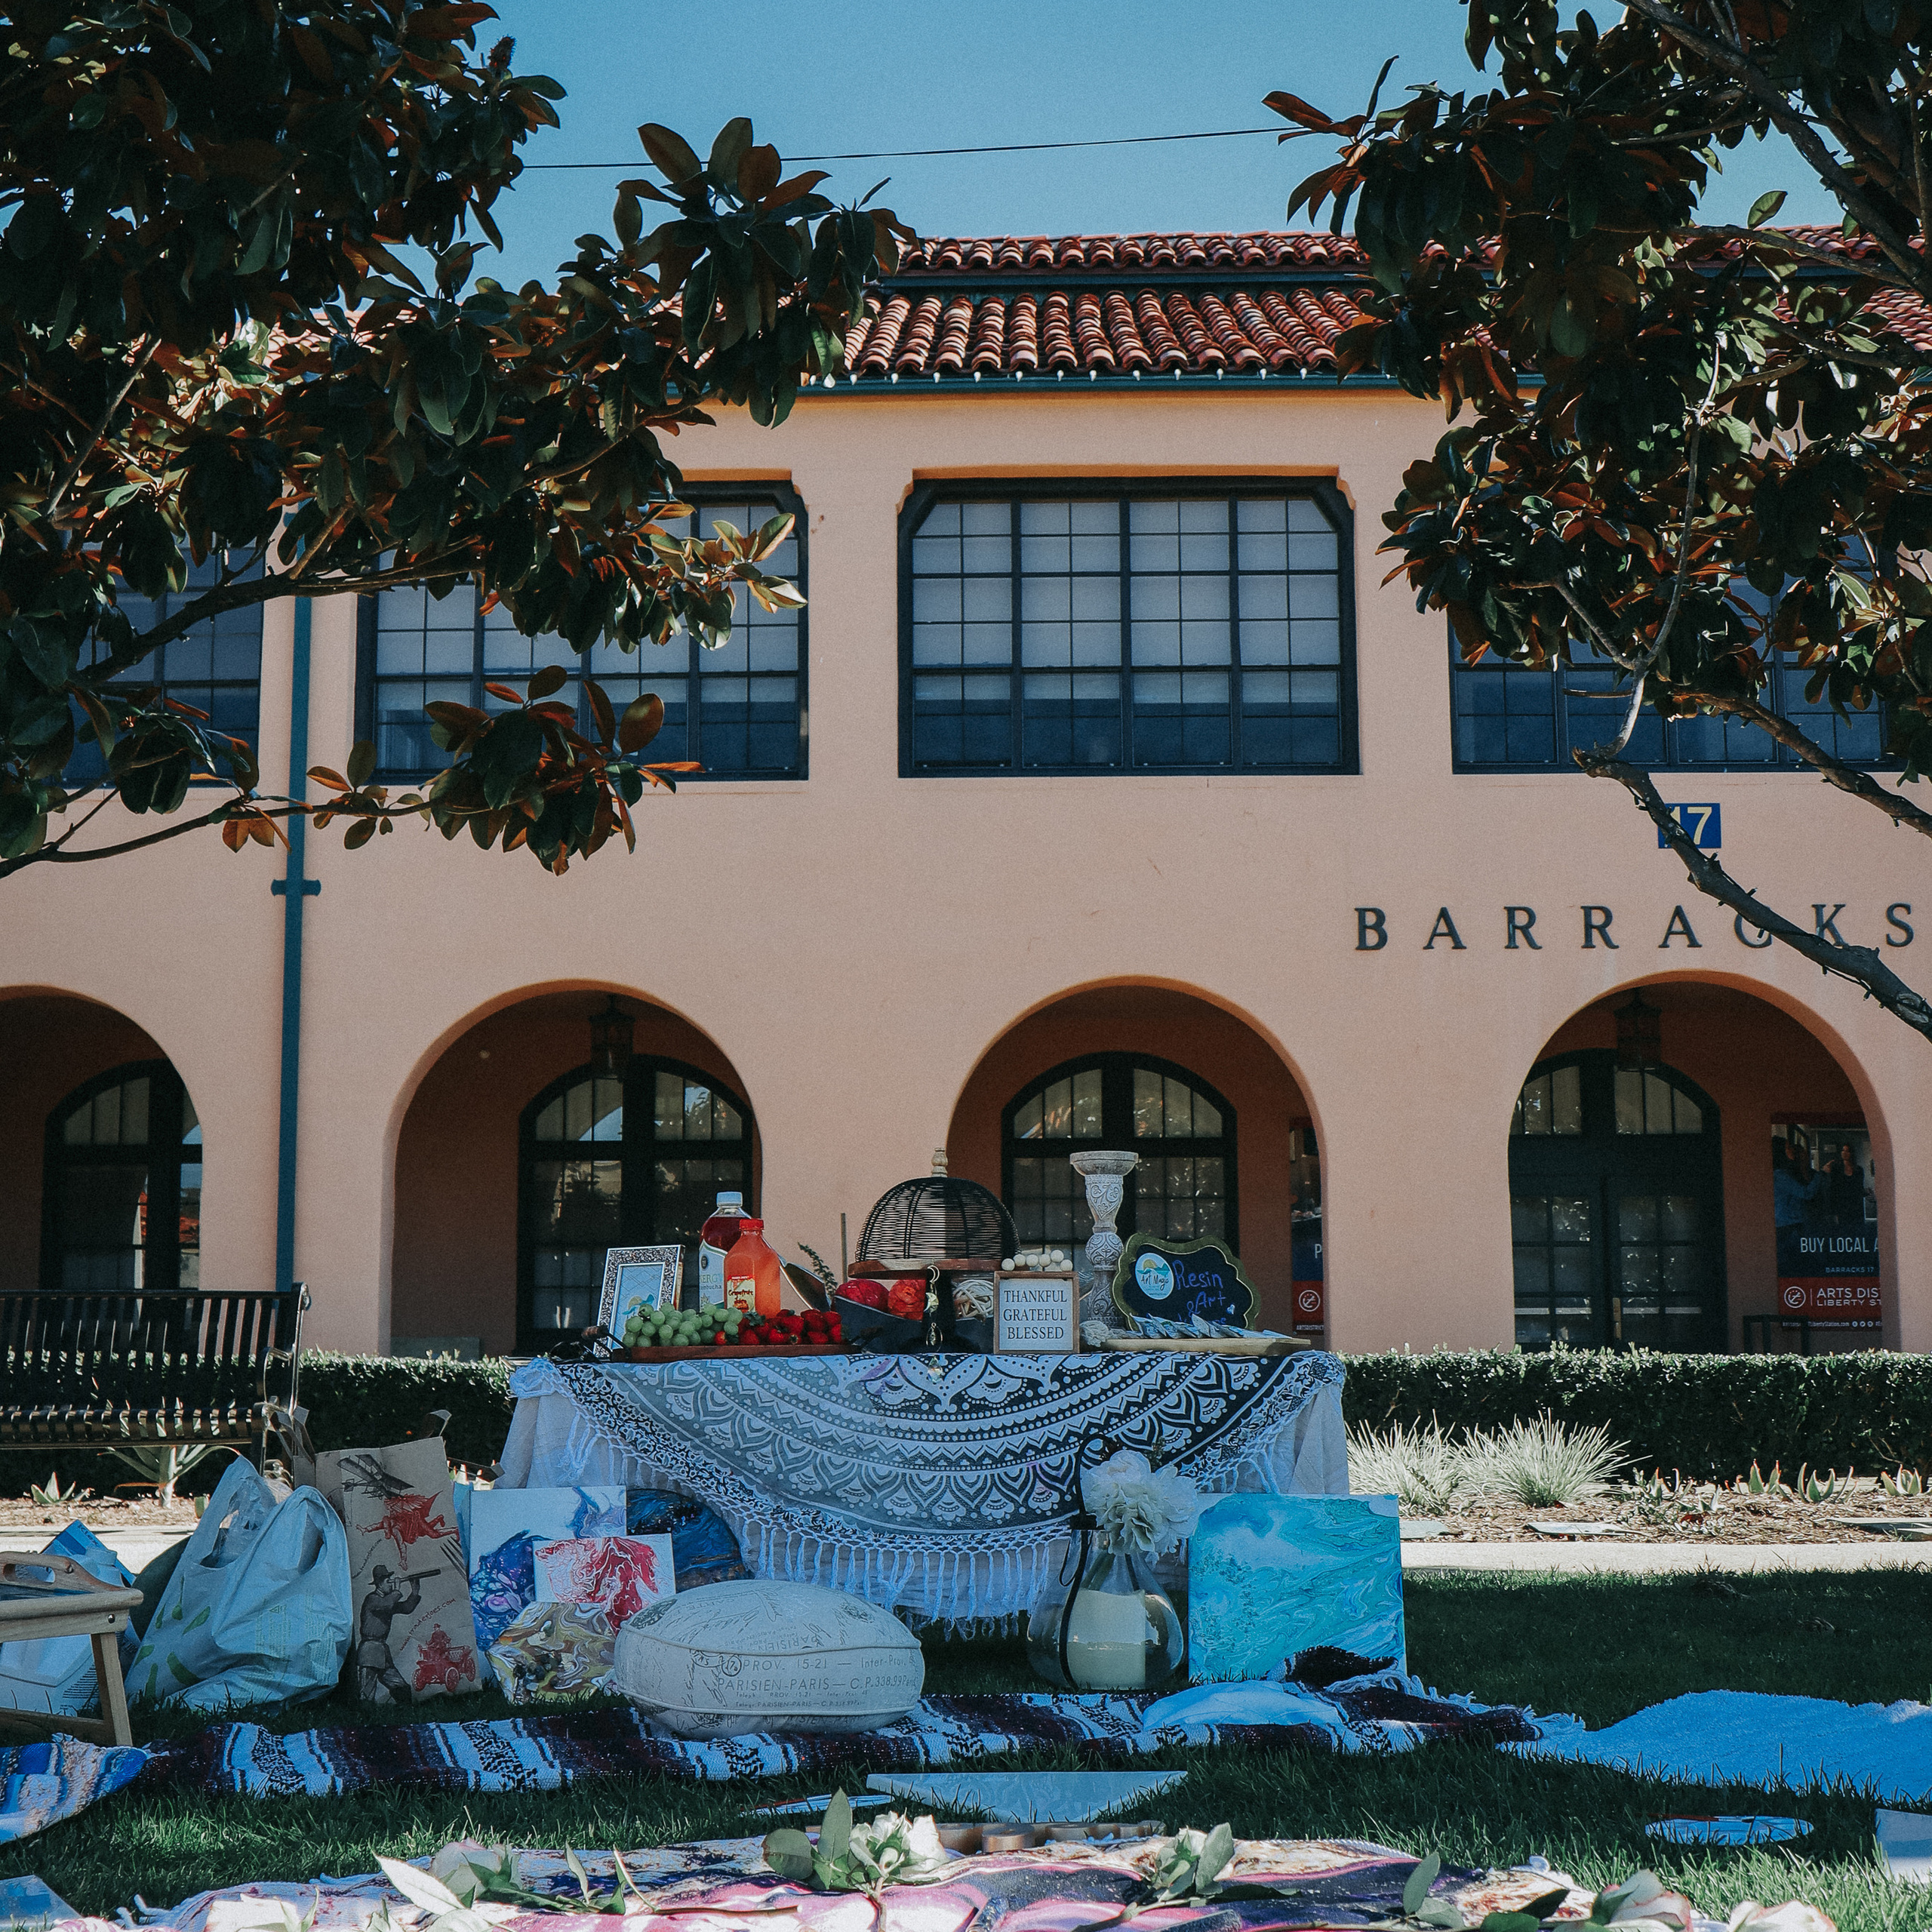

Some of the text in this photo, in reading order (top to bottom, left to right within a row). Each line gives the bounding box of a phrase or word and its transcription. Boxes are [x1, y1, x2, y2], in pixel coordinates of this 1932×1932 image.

[1355, 903, 1915, 950] BARRACKS
[1800, 1237, 1825, 1253] BUY
[1829, 1237, 1869, 1253] LOCAL
[1172, 1260, 1223, 1291] Resin
[1004, 1290, 1067, 1303] THANKFUL
[1817, 1287, 1852, 1298] ARTS
[1195, 1291, 1226, 1312] Art
[1003, 1309, 1067, 1321] GRATEFUL
[1007, 1327, 1064, 1340] BLESSED
[743, 1660, 786, 1671] PROV.
[797, 1658, 826, 1670] 15-21
